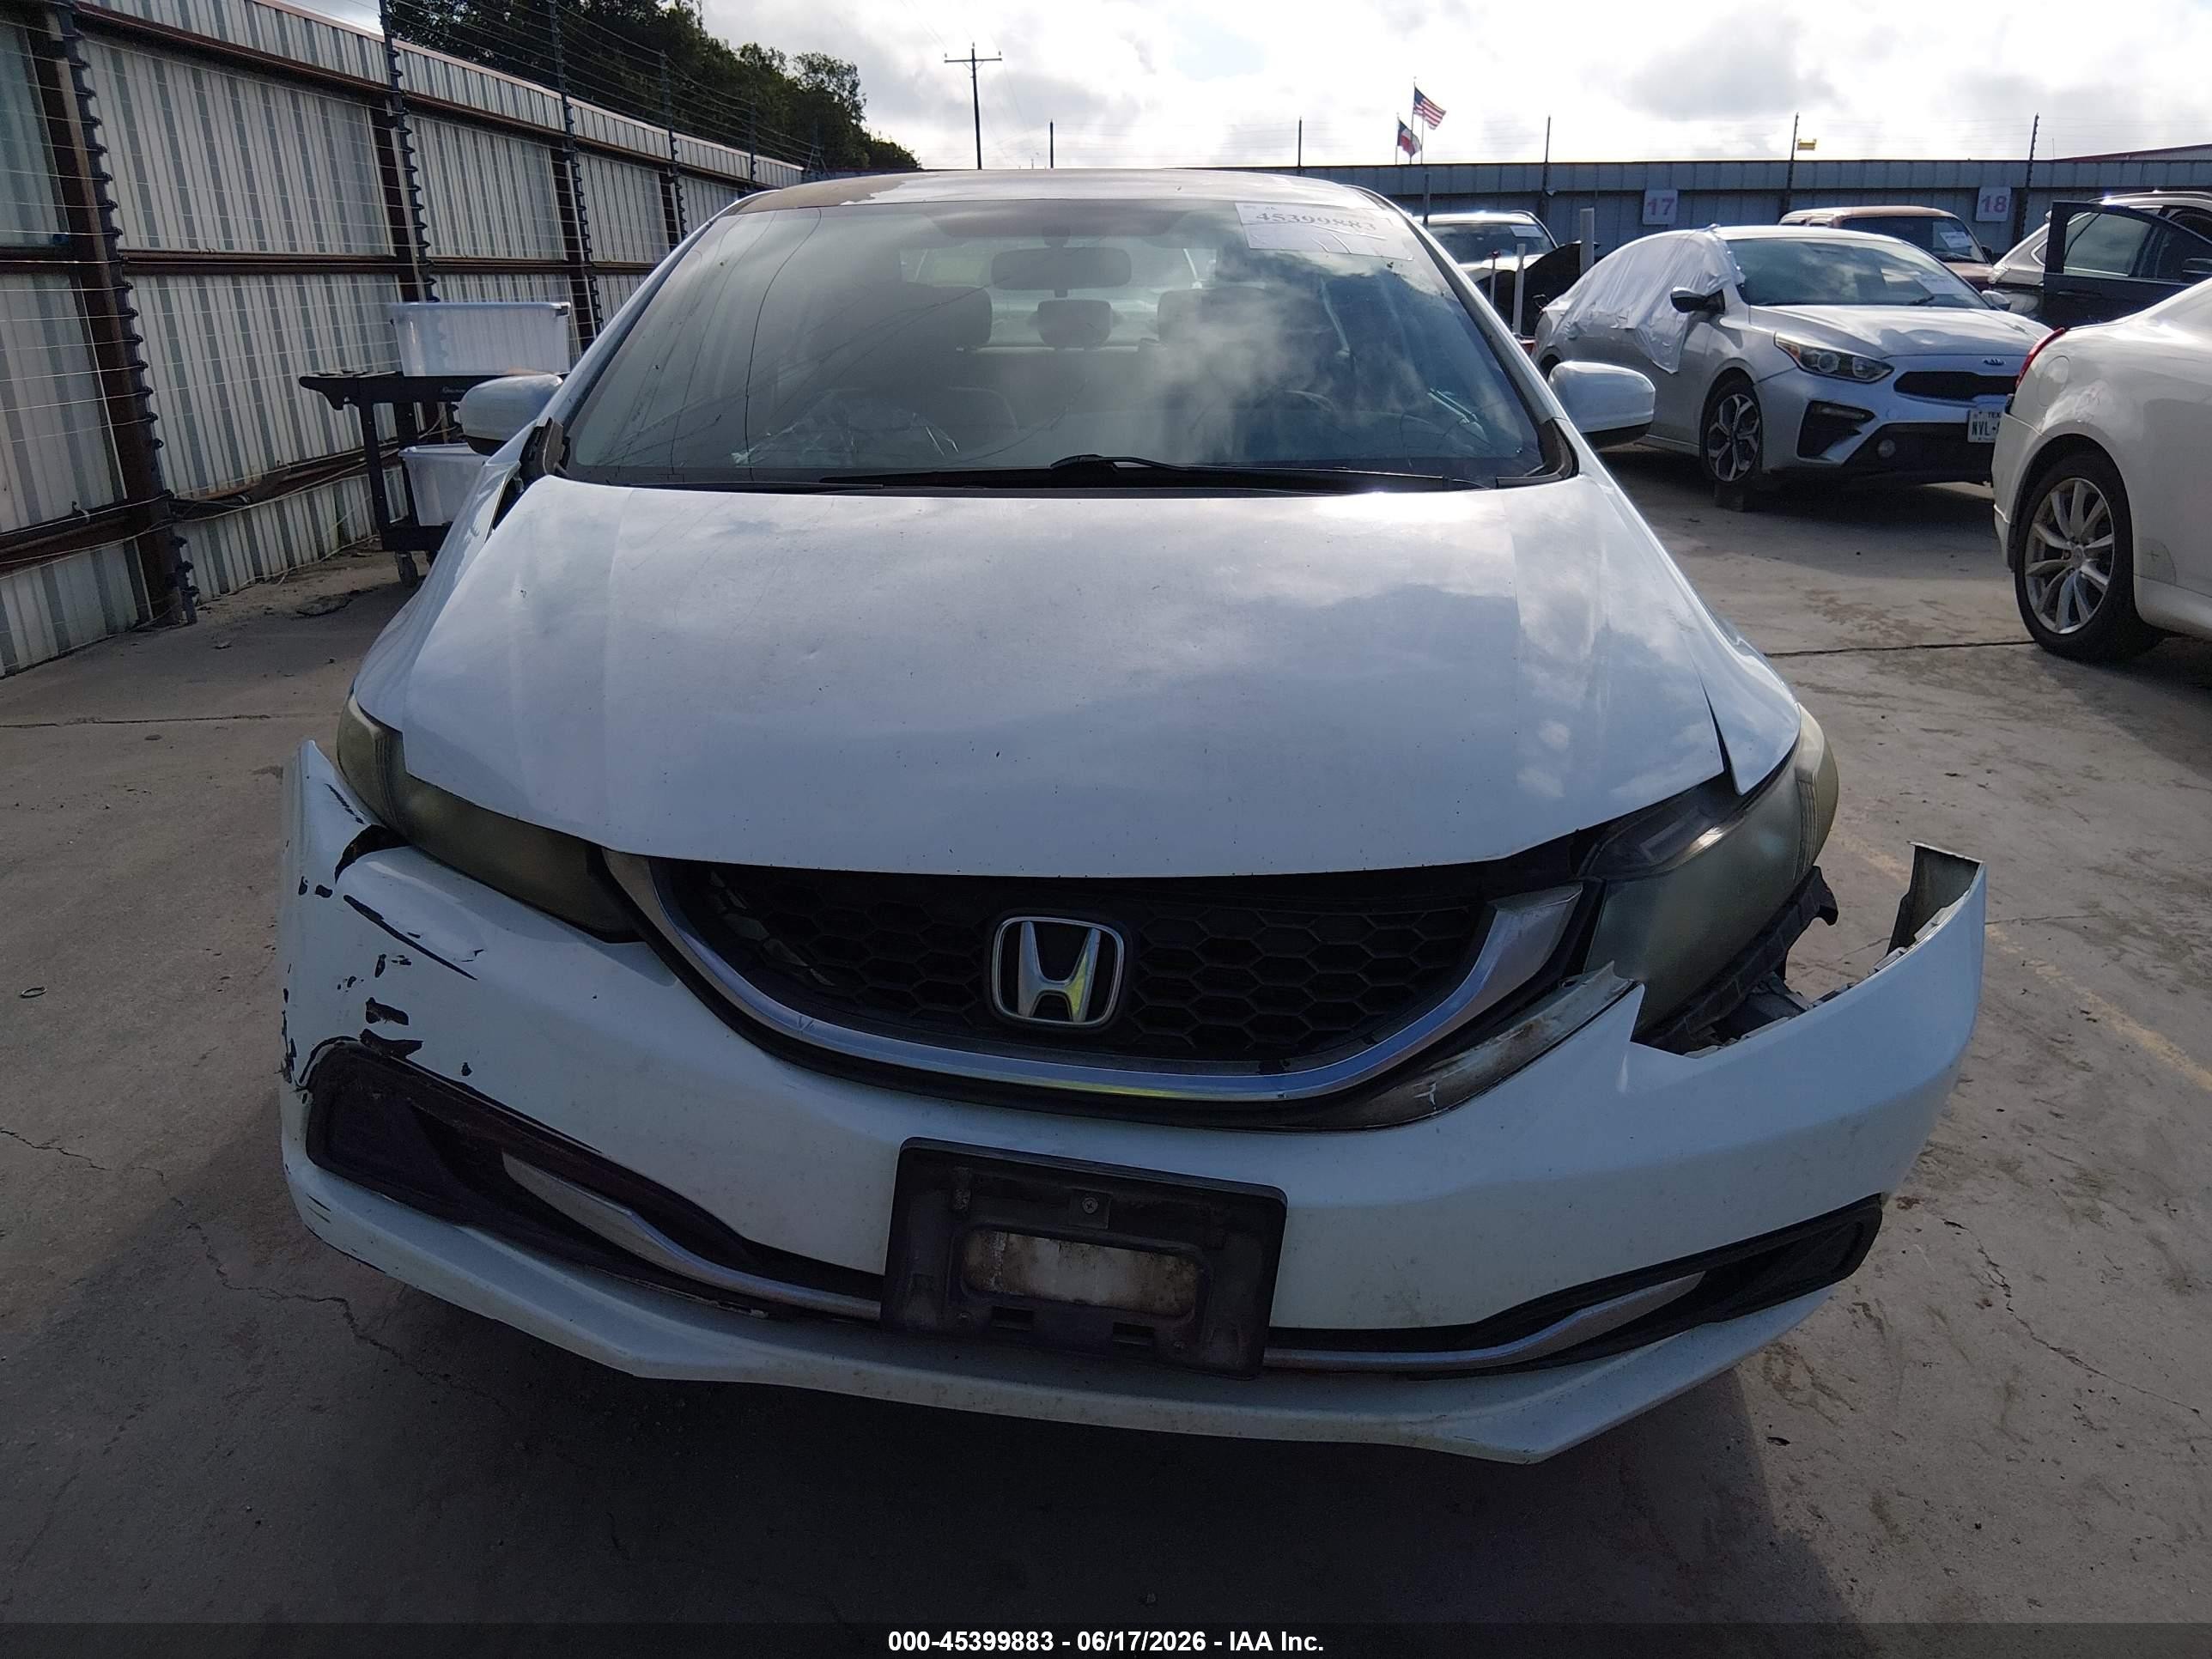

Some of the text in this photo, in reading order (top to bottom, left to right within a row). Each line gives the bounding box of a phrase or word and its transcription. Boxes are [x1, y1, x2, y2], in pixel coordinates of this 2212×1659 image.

[1648, 197, 1675, 216] 17
[1981, 196, 2007, 213] 18
[1256, 211, 1376, 231] 45399883
[1972, 421, 2000, 436] NYL
